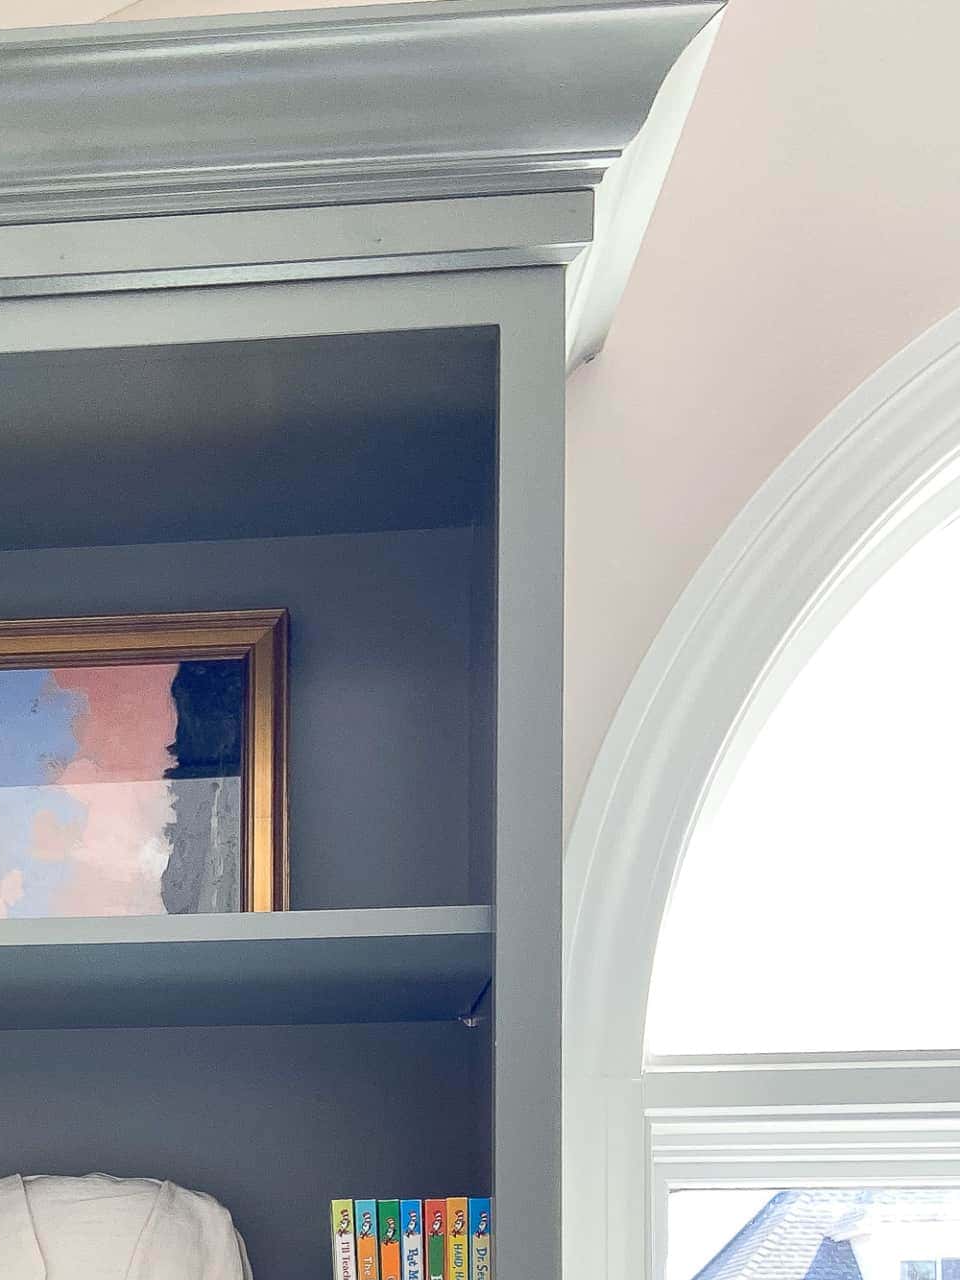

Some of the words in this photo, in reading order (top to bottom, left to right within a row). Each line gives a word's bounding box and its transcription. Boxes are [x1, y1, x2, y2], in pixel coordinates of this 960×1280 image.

[407, 1248, 418, 1266] Put
[452, 1244, 464, 1268] HAND,
[476, 1248, 488, 1262] Dr.
[342, 1256, 351, 1280] Teach
[364, 1256, 372, 1276] The
